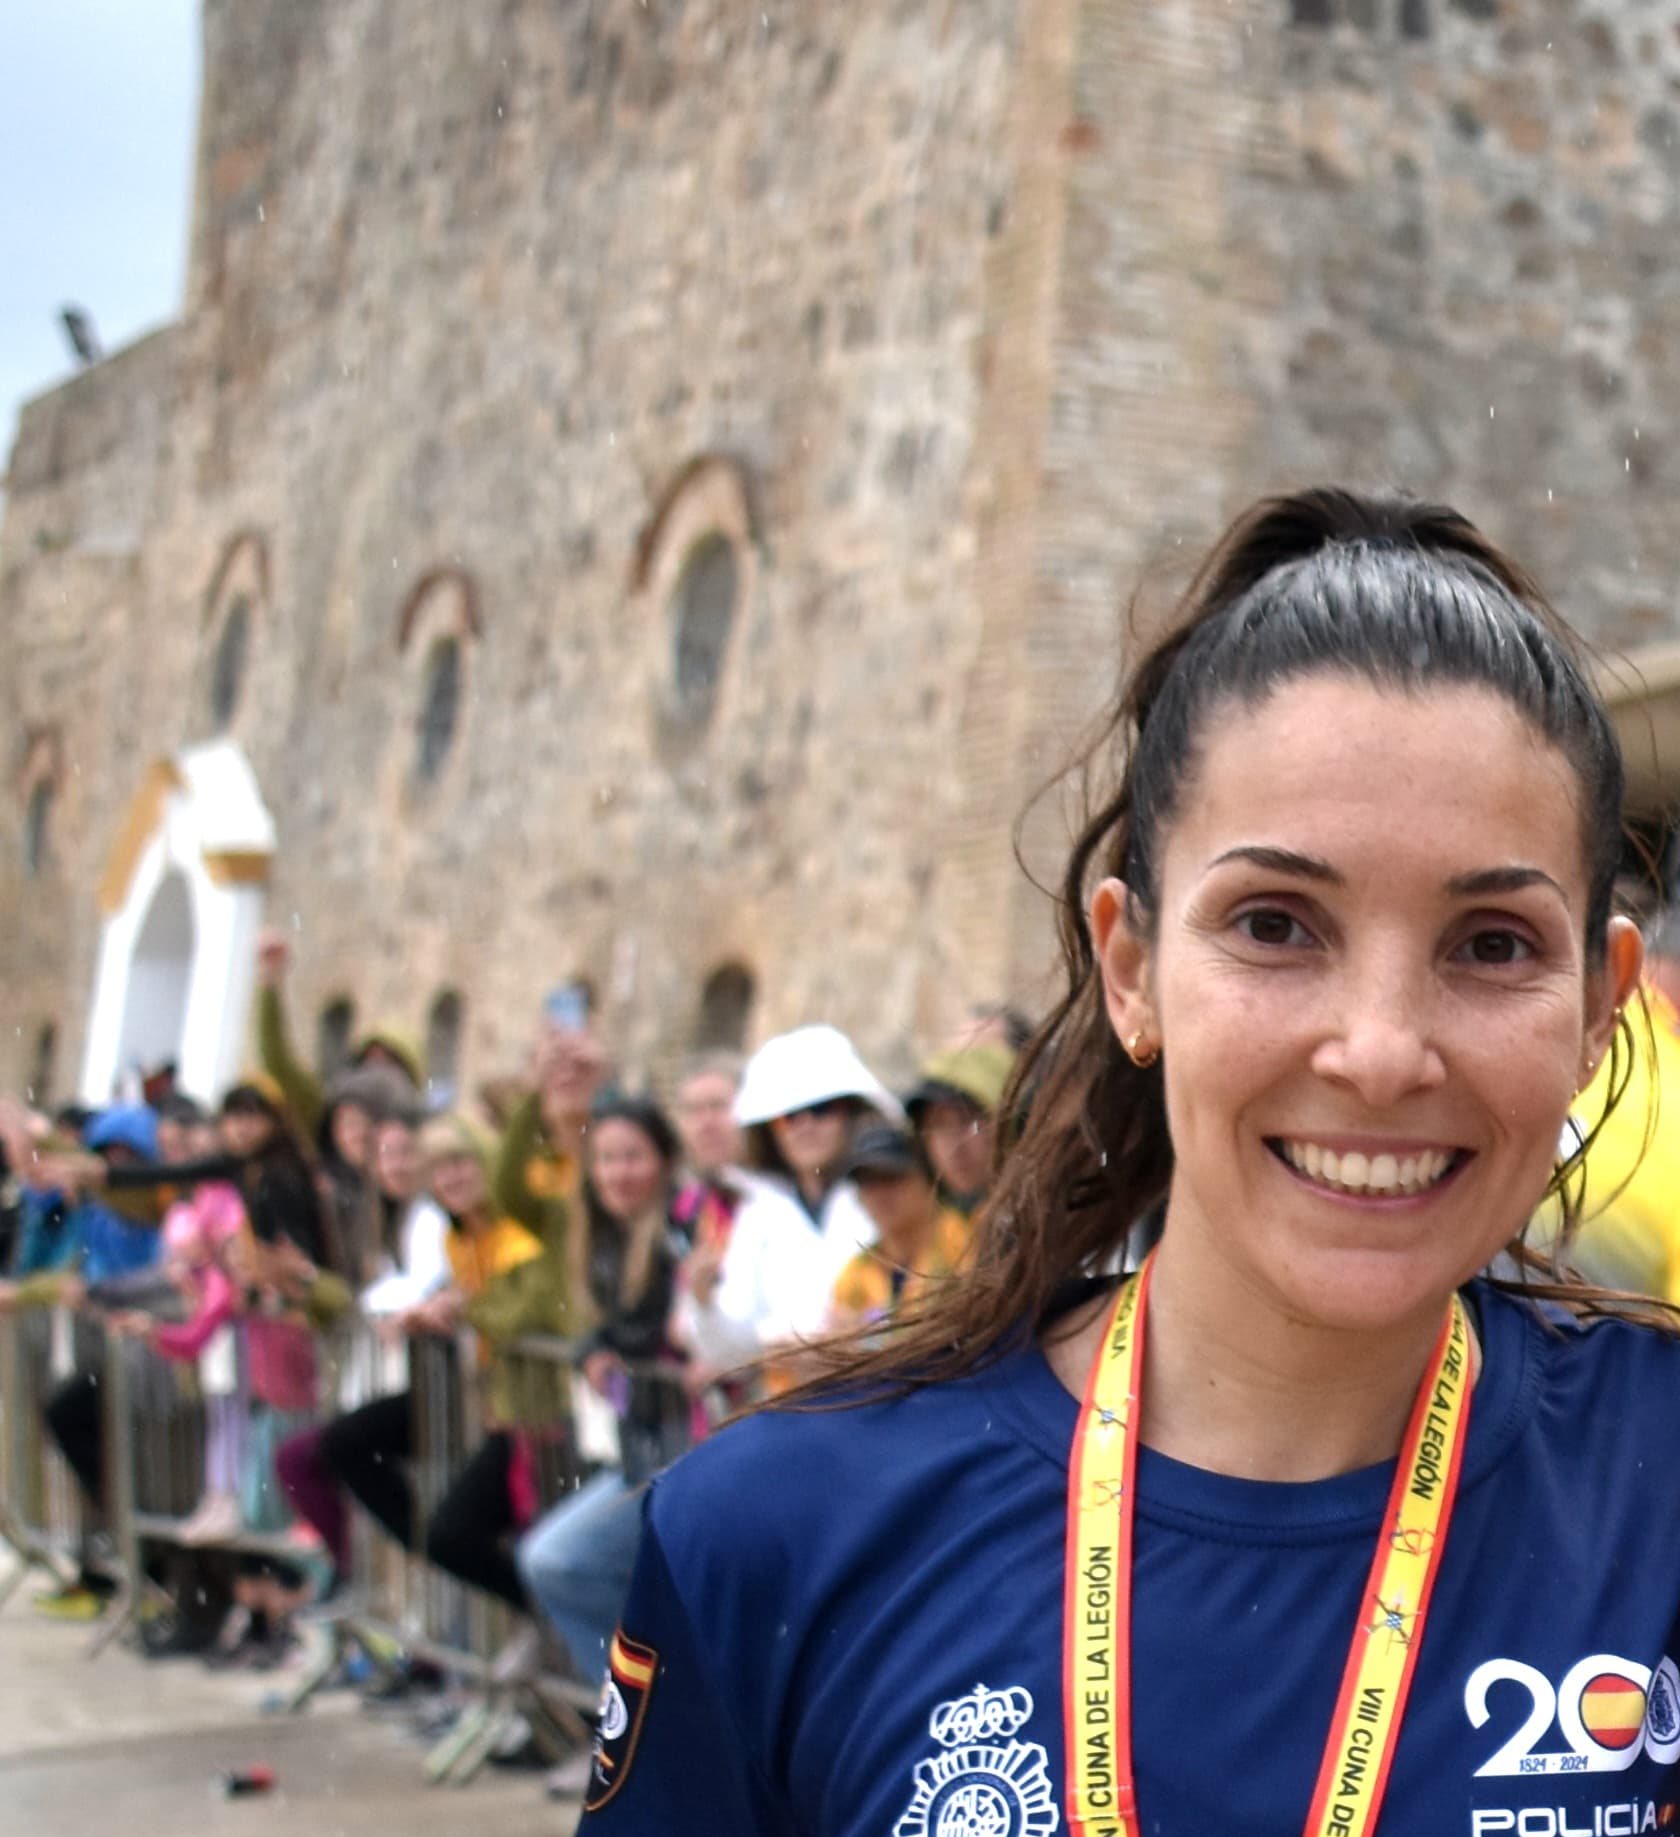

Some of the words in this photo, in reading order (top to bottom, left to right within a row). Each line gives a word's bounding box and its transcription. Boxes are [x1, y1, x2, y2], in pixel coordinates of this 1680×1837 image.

[1432, 1379, 1456, 1413] LA
[1411, 1411, 1449, 1501] LEGIÓN
[1083, 1545, 1112, 1641] LEGIÓN
[1086, 1648, 1109, 1681] LA
[1086, 1690, 1110, 1725] DE
[1357, 1687, 1385, 1723] VIII
[1087, 1731, 1112, 1808] CUNA
[1337, 1728, 1373, 1797] CUNA
[1560, 1755, 1589, 1771] 2024
